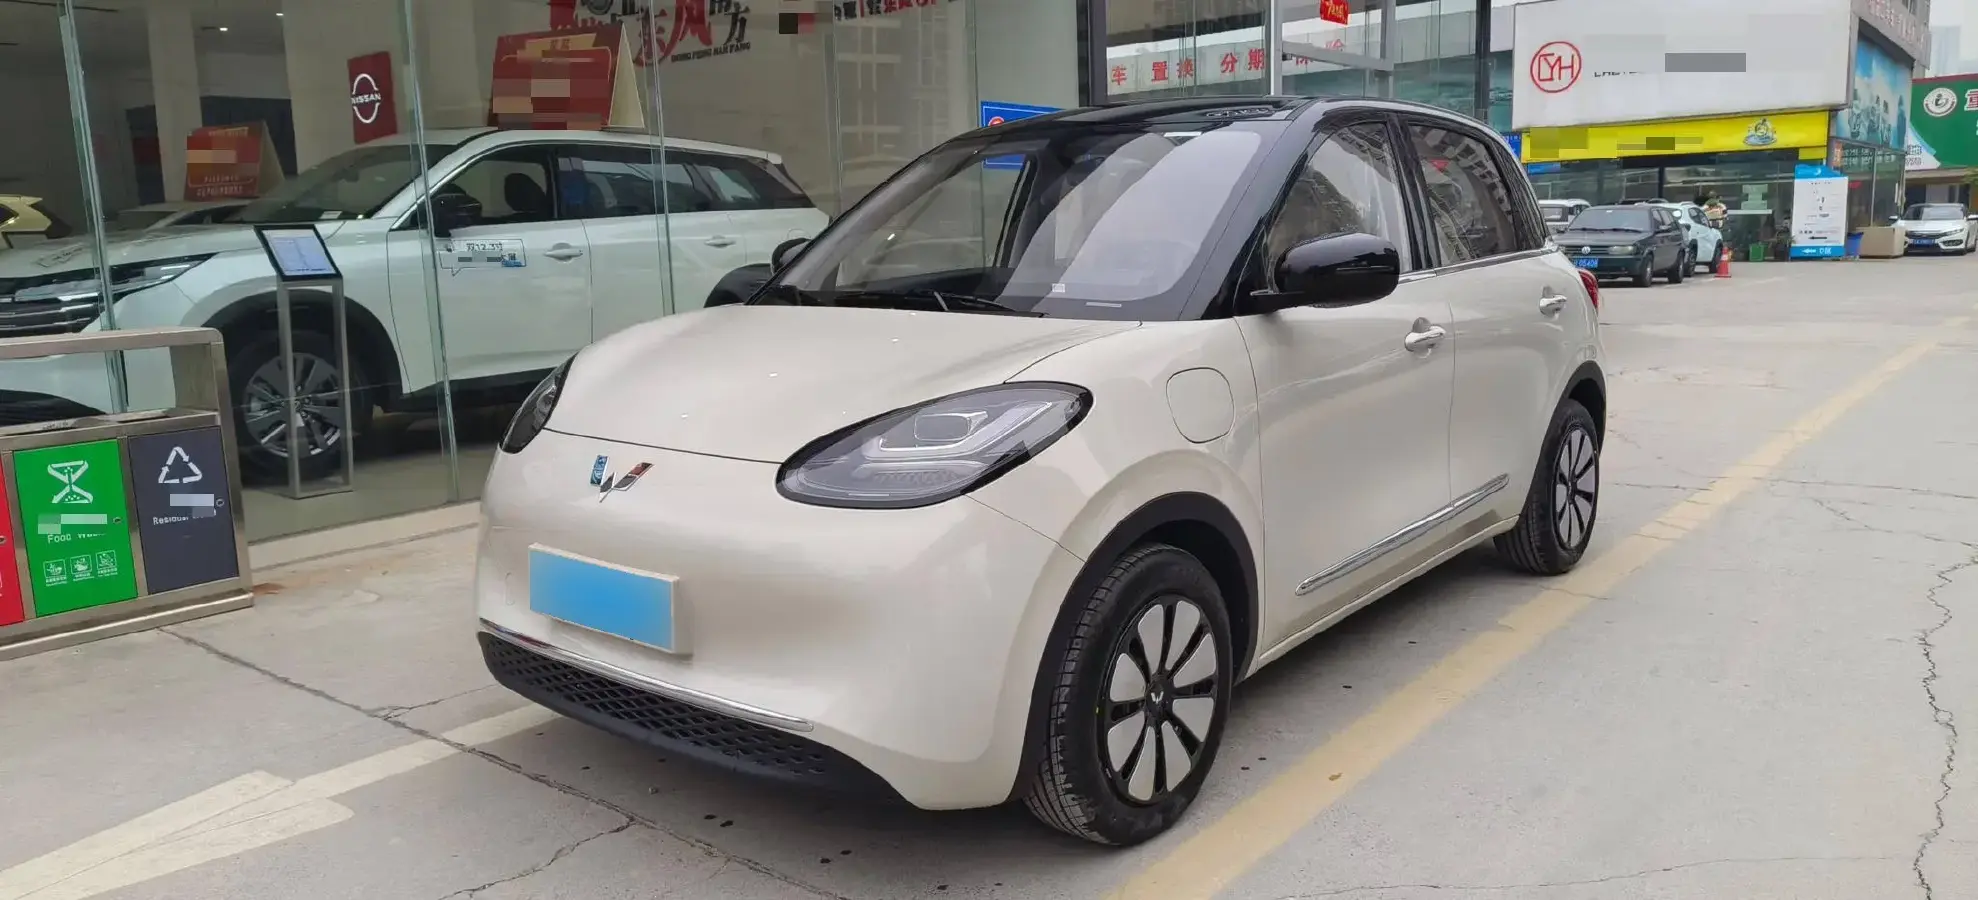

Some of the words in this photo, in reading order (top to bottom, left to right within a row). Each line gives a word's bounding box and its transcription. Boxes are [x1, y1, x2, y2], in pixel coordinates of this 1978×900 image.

[1111, 65, 1127, 86] 车
[1220, 48, 1265, 73] 分期
[351, 93, 381, 104] NISSAN
